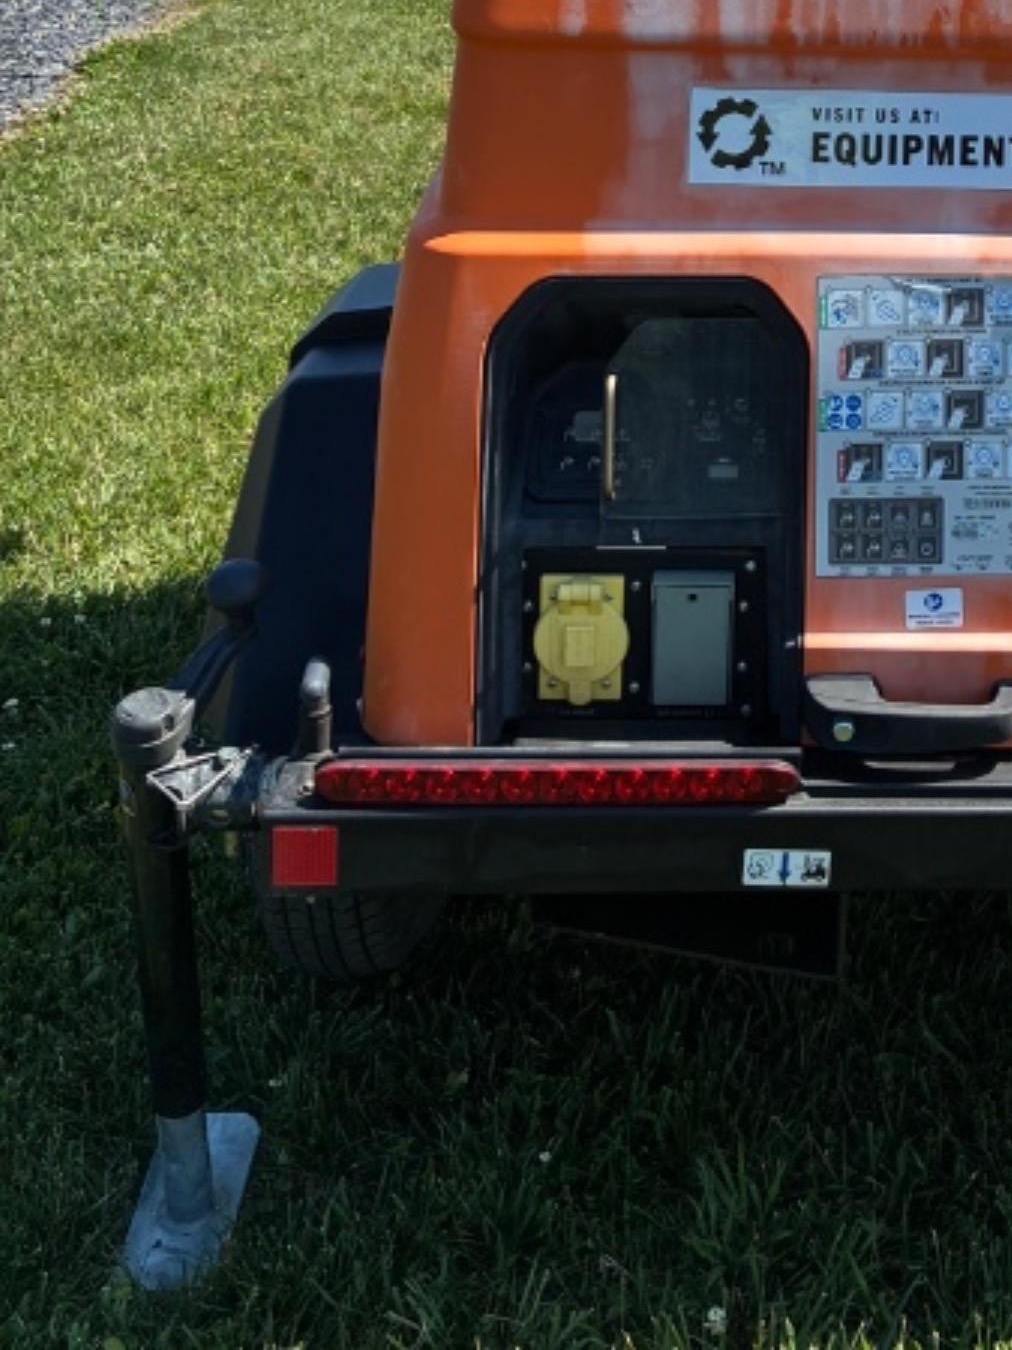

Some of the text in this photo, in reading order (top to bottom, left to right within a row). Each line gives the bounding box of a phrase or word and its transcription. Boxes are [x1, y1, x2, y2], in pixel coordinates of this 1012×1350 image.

[811, 107, 865, 123] VISIT
[875, 108, 900, 123] US
[759, 161, 787, 177] TM
